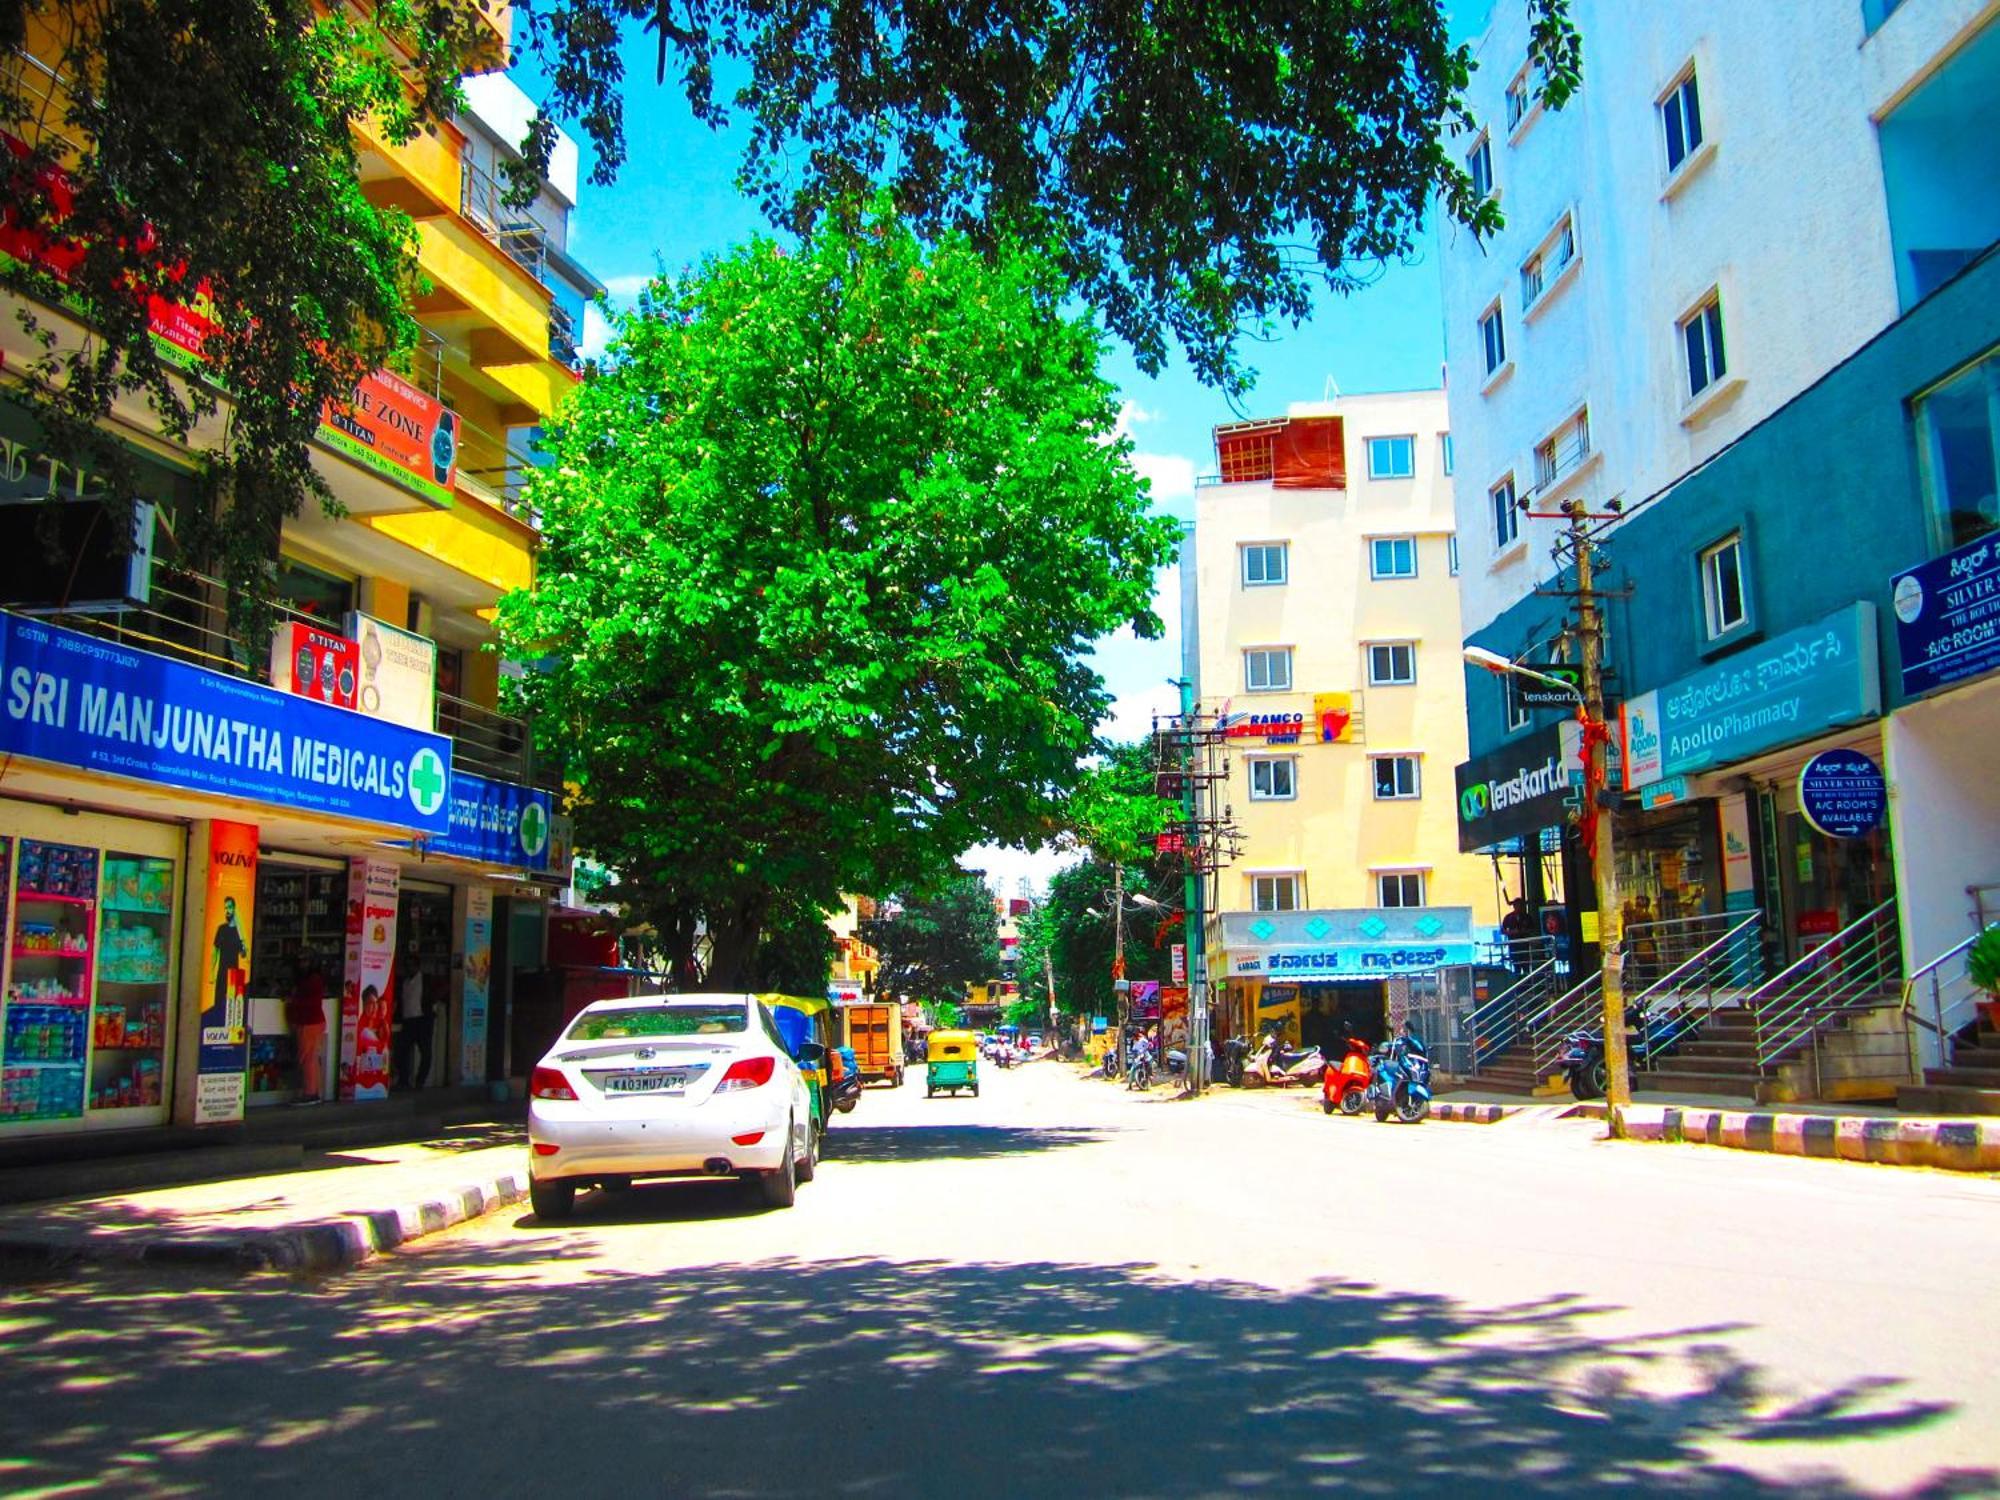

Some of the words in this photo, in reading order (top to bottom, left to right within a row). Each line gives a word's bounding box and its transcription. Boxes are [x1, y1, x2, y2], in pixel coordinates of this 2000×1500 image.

[343, 418, 374, 442] TITAN
[376, 401, 424, 442] ZONE
[1947, 578, 1995, 609] SILVER
[17, 626, 48, 643] GSTIN
[317, 635, 347, 653] TITAN
[1928, 636, 1950, 658] A/C
[1250, 712, 1303, 725] RAMCO
[8, 666, 69, 728] SRI
[78, 683, 283, 775] MANJUNATHA
[291, 735, 405, 799] MEDICALS
[1809, 779, 1843, 789] SILVER
[1815, 800, 1833, 810] A/C
[1821, 812, 1873, 823] AVAILABLE
